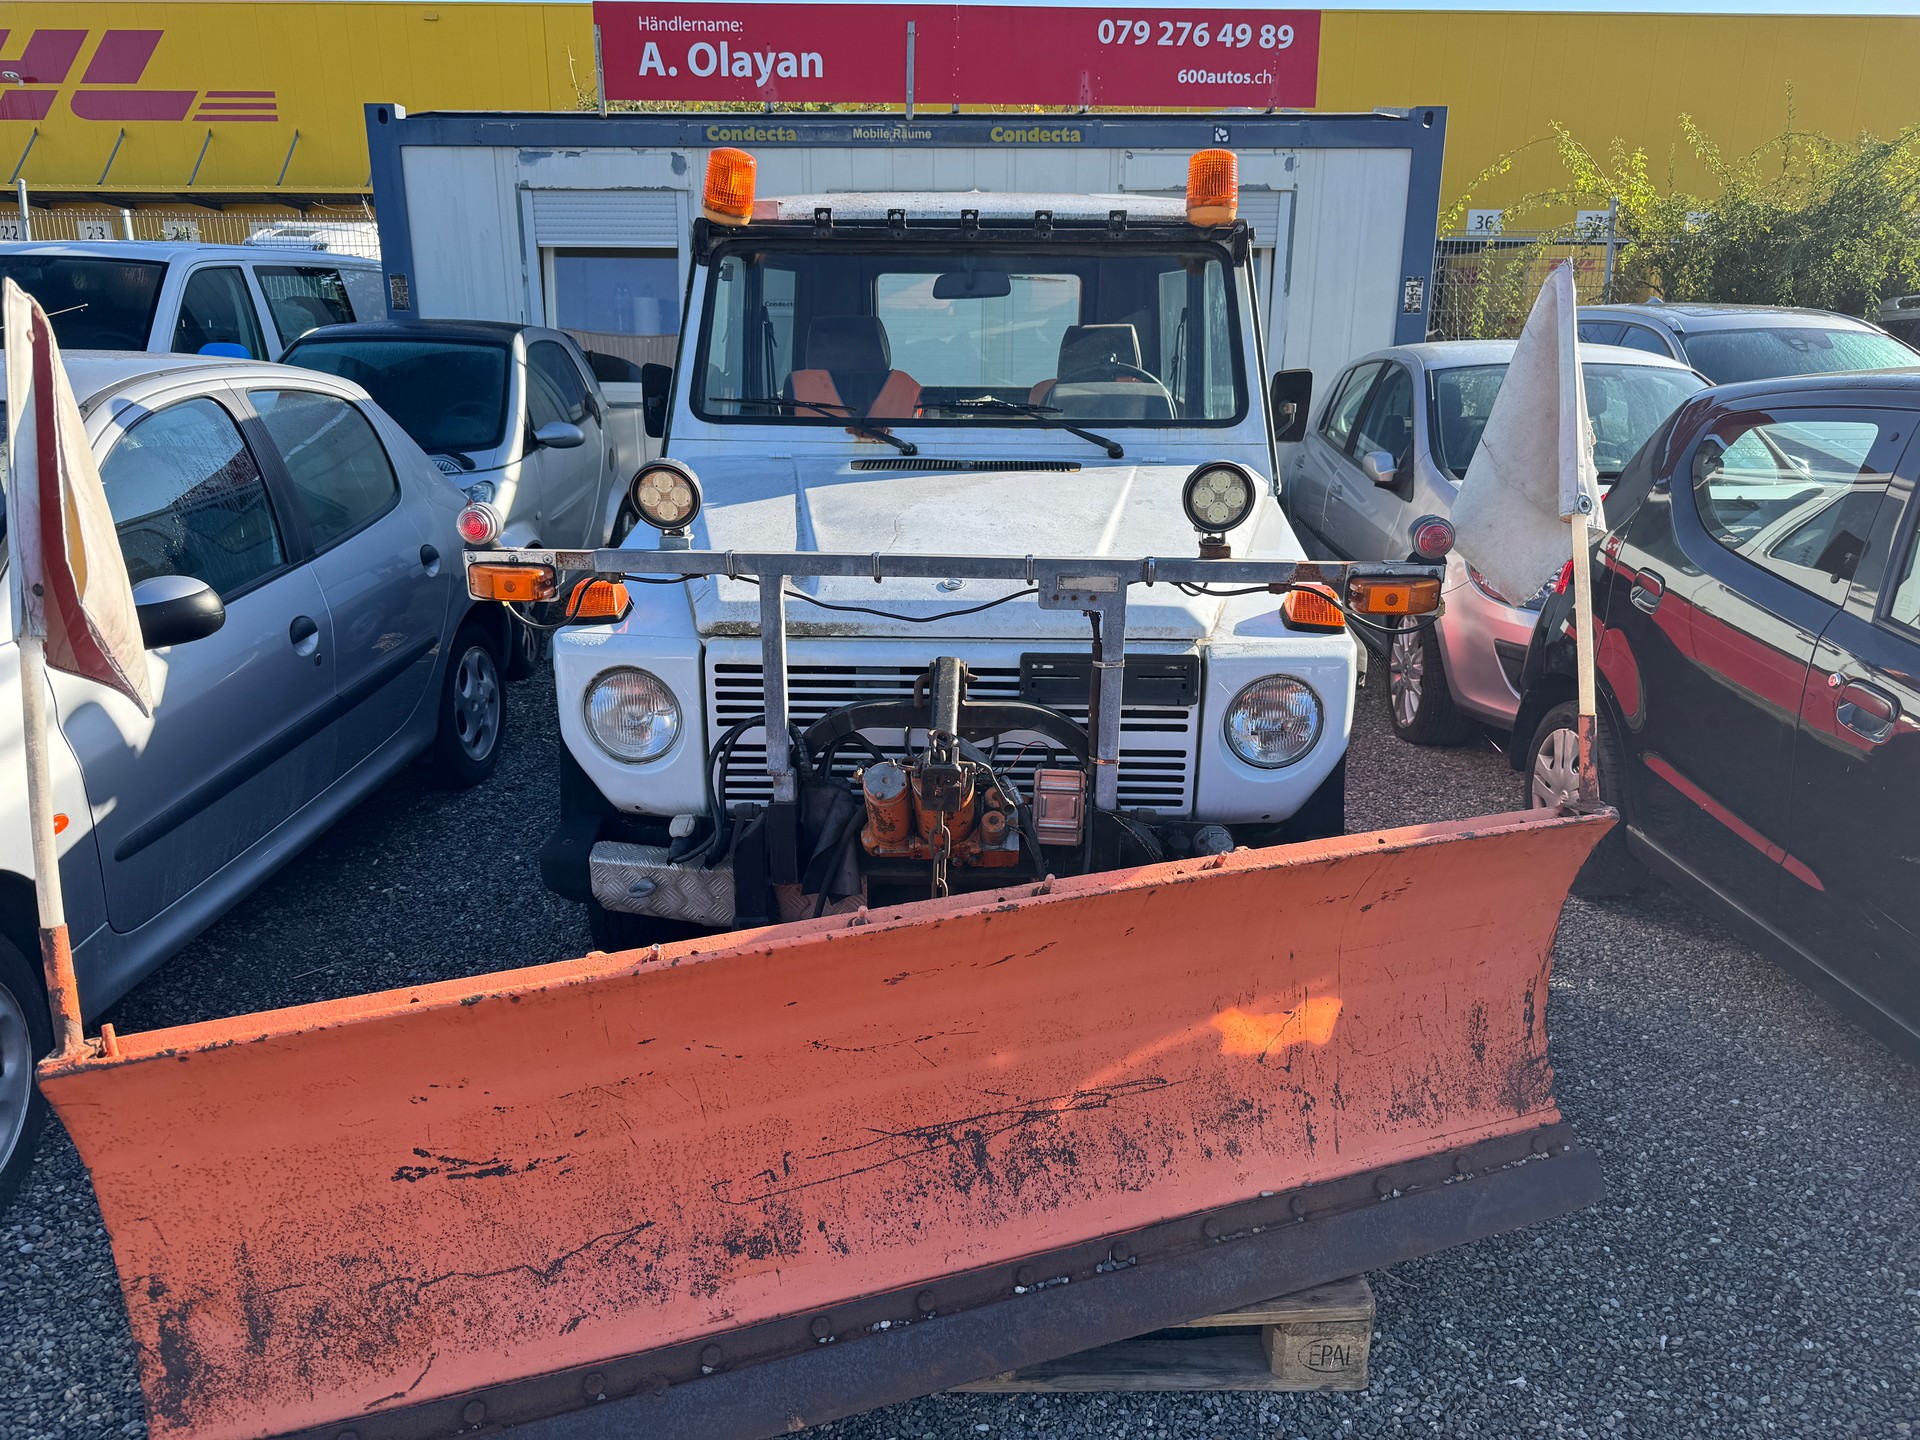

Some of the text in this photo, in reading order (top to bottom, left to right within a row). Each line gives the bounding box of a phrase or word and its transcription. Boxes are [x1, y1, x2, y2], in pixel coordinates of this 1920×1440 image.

[638, 16, 743, 33] Händlername:
[1098, 19, 1295, 50] 079 276 49 89
[638, 41, 824, 88] A. Olayan
[0, 29, 198, 121] HL
[1177, 68, 1272, 86] 600autos.ch
[706, 126, 797, 142] Condecta
[853, 127, 932, 140] Mobile Räume
[990, 127, 1081, 143] Condecta
[1475, 215, 1493, 230] 36
[86, 226, 105, 240] 23
[1308, 1344, 1354, 1366] EPAL
